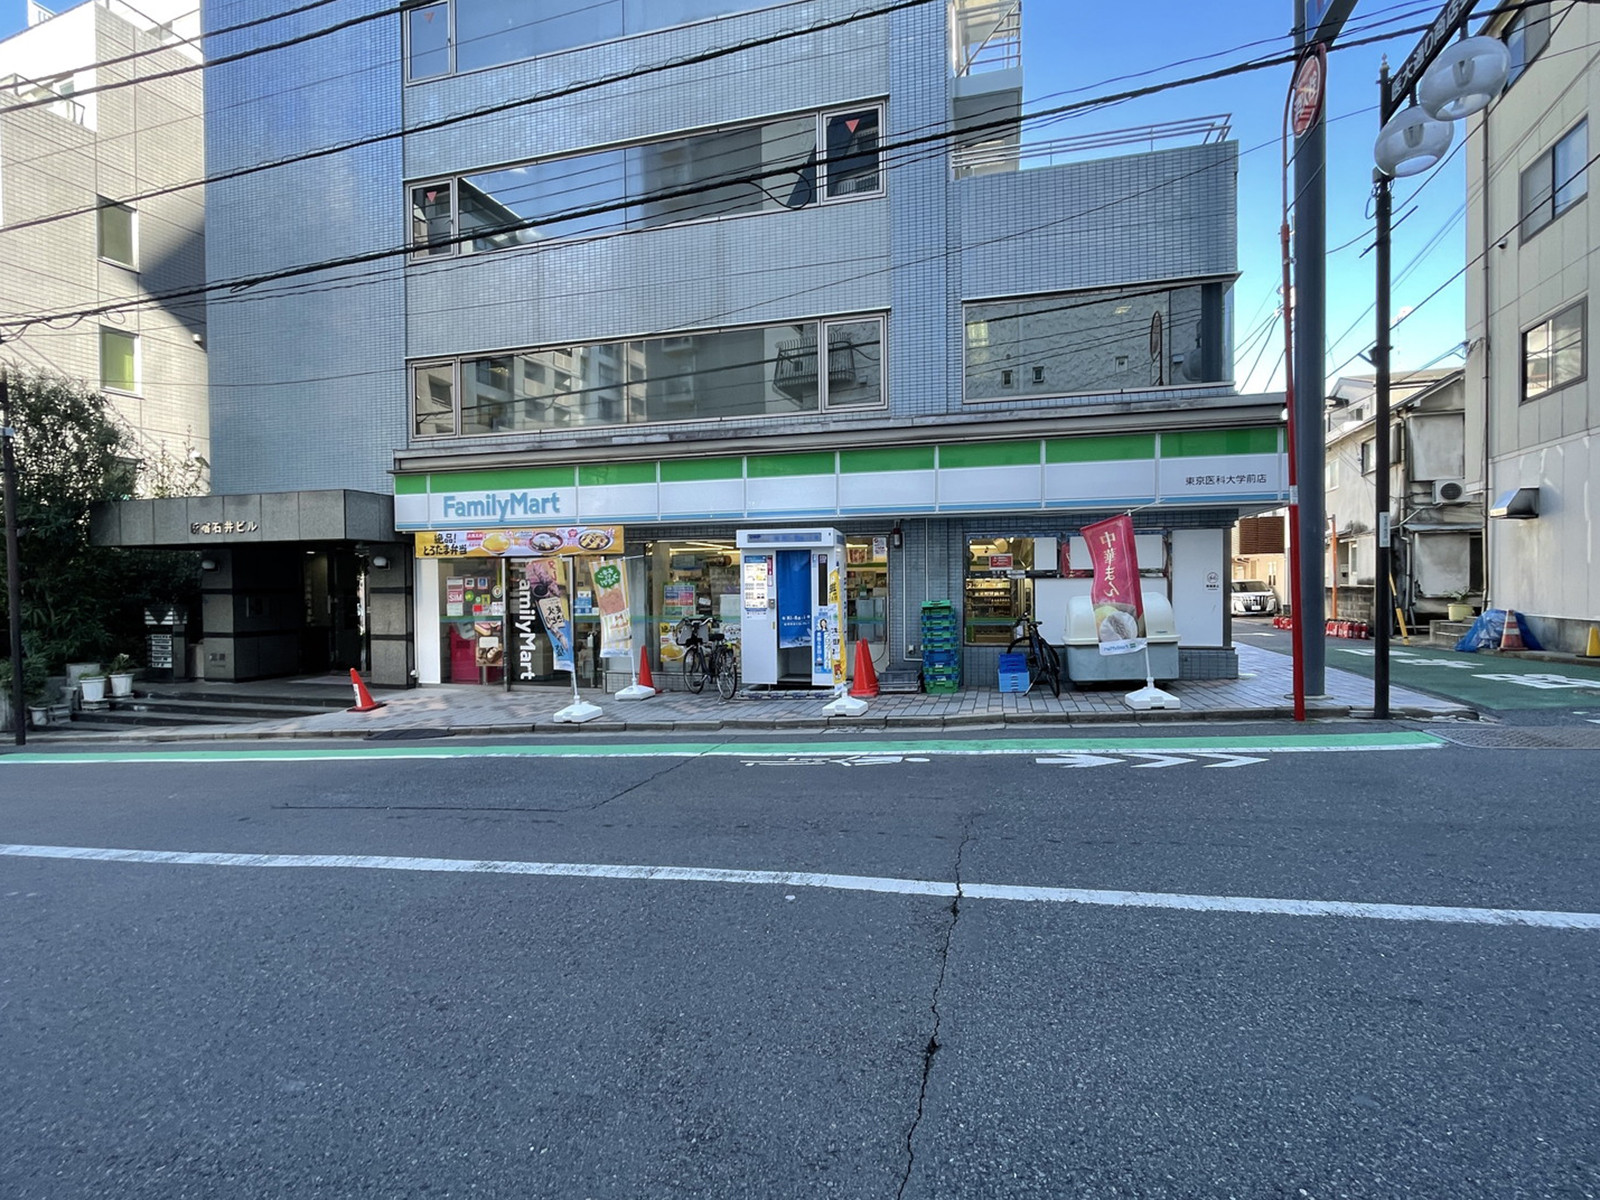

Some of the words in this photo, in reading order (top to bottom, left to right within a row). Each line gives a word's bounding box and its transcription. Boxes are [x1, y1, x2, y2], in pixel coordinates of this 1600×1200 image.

[1185, 474, 1267, 486] 東京医科大学前店
[443, 491, 560, 521] FamilyMart
[423, 543, 466, 557] とろたま弁当
